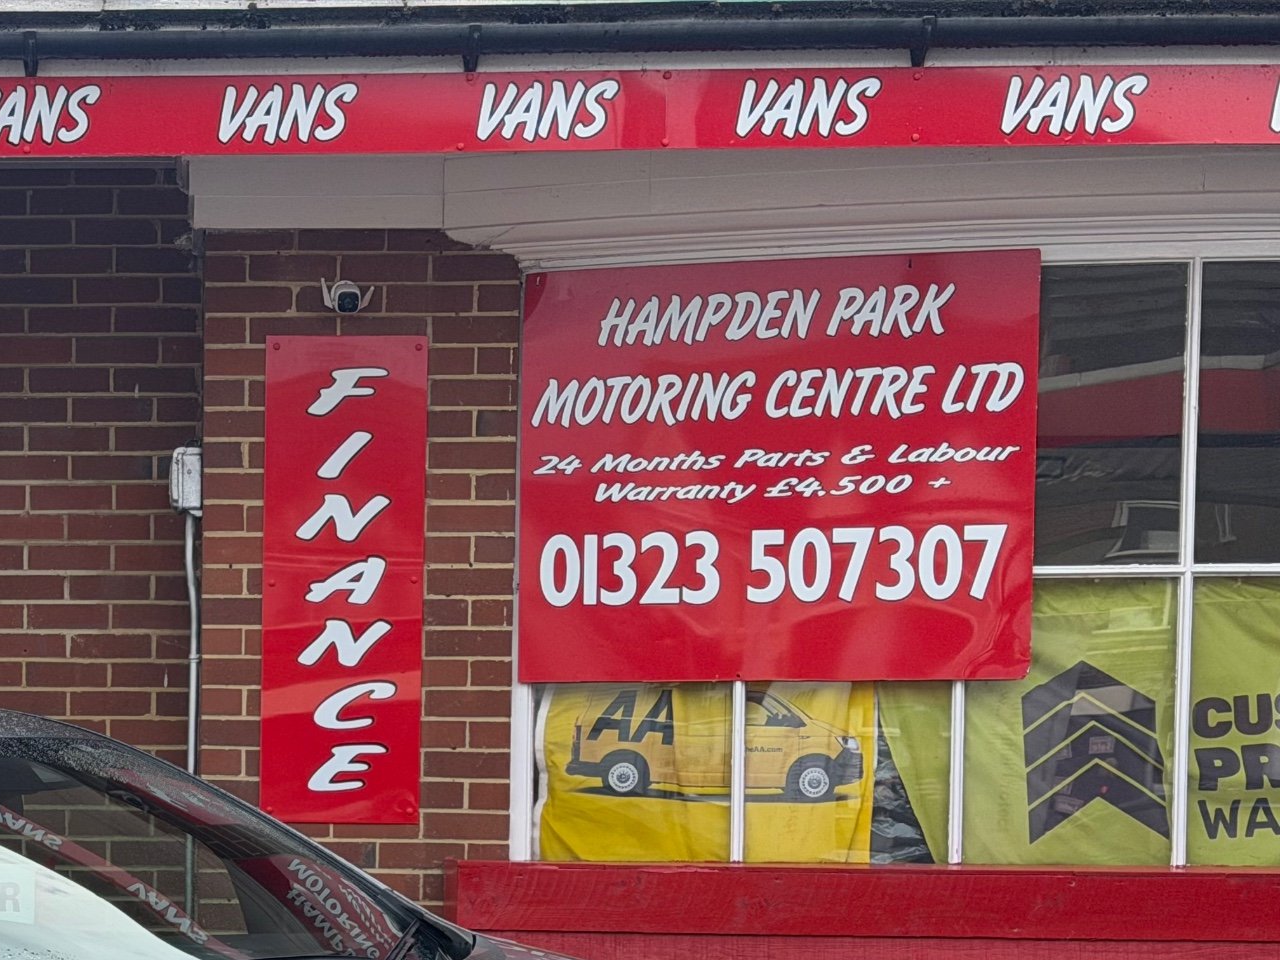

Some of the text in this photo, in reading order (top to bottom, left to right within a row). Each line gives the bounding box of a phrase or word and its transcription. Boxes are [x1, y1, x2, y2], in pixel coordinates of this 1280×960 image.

[216, 81, 359, 145] VANS
[474, 78, 621, 143] VANS
[734, 75, 882, 140] VANS
[999, 72, 1149, 138] VANS
[597, 282, 956, 348] HAMPDEN PARK
[530, 361, 1025, 428] MOTORING CENTRE LTD
[533, 441, 1021, 476] 24 Months Parts & Labour
[595, 480, 756, 504] Warranty
[927, 475, 952, 490] +
[295, 367, 397, 793] FINANCE
[539, 524, 1008, 608] 01323 507307
[585, 690, 674, 745] AA
[1192, 692, 1280, 739] CU
